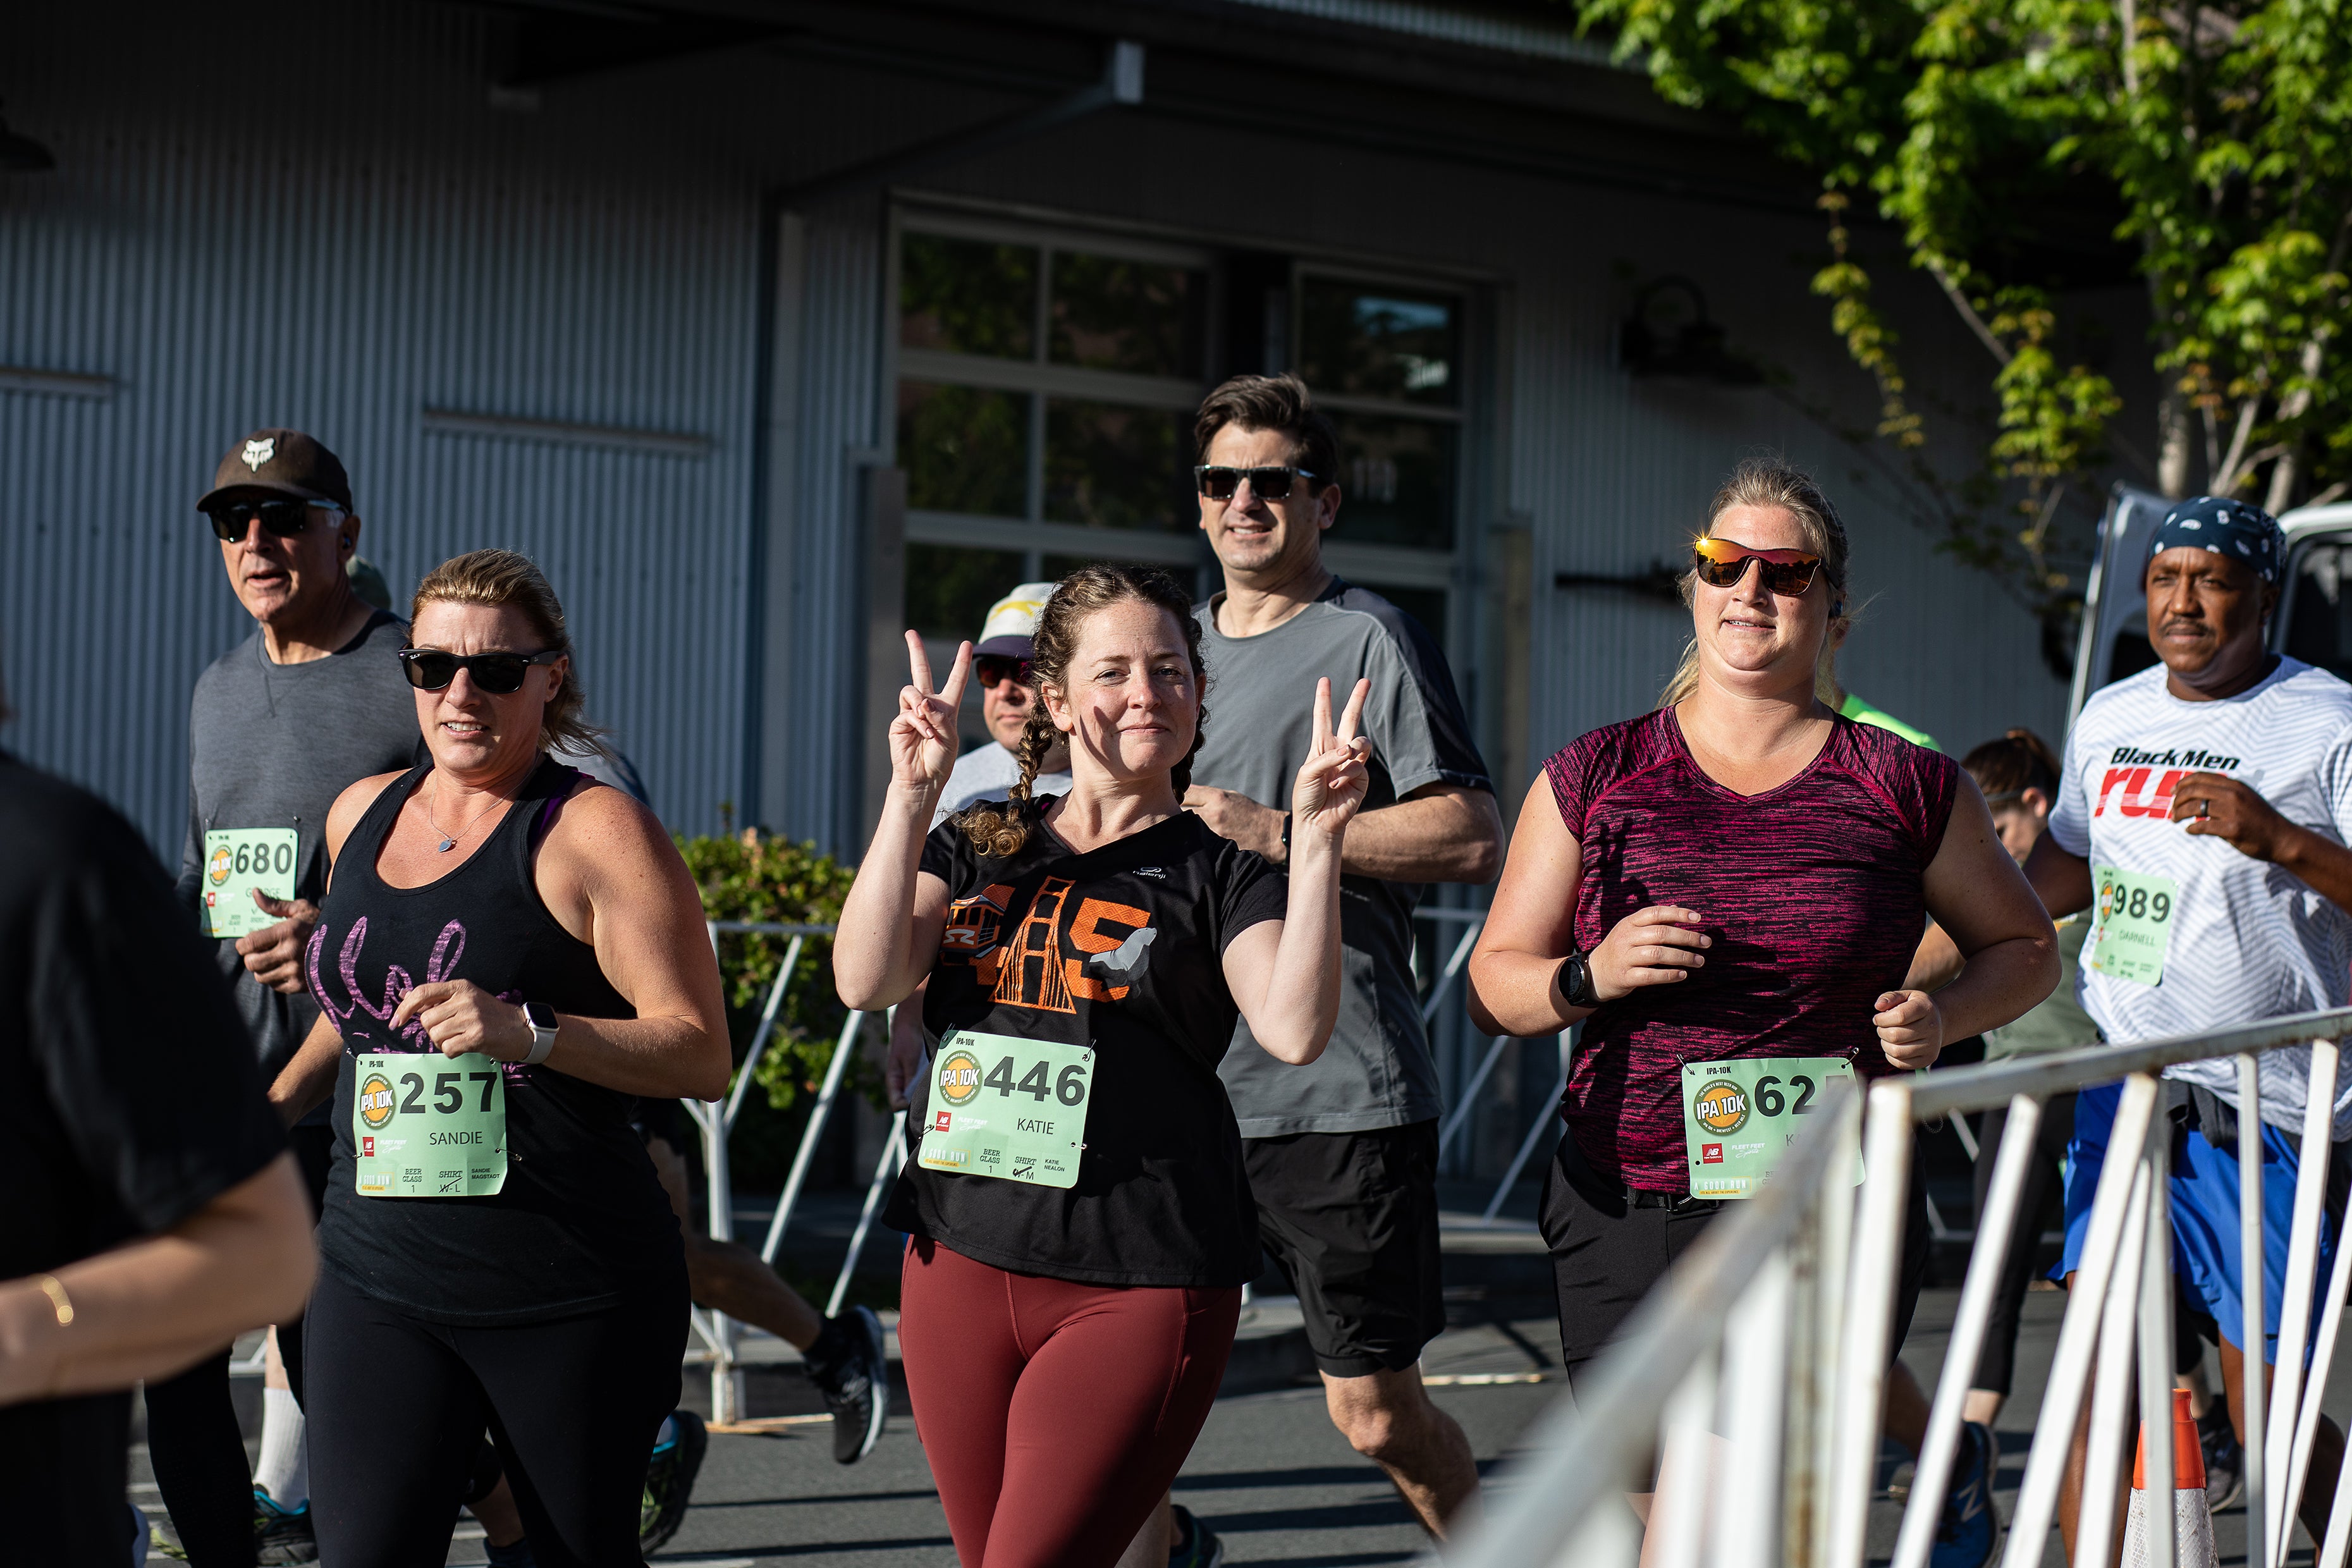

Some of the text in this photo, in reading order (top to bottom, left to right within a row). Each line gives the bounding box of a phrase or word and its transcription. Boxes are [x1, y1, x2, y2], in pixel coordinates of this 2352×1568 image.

[235, 843, 292, 874] 680
[2114, 883, 2170, 922] 989
[956, 1038, 975, 1046] IPA-10K
[940, 1069, 981, 1086] IPA 10K
[1706, 1066, 1732, 1075] IPA-10K
[984, 1056, 1087, 1106] 446
[400, 1072, 498, 1114] 257
[1754, 1075, 1850, 1117] 62
[360, 1089, 393, 1112] IPA 10K
[1696, 1094, 1746, 1120] IPA 10K
[1017, 1118, 1055, 1135] KATIE
[429, 1131, 483, 1145] SANDIE
[983, 1148, 1000, 1156] BEER
[1014, 1156, 1037, 1166] SHIRT
[989, 1165, 992, 1173] 1
[1026, 1171, 1034, 1180] M
[412, 1185, 415, 1193] 1
[455, 1184, 460, 1192] L
[1694, 1179, 1746, 1190] A GOOD RUN
